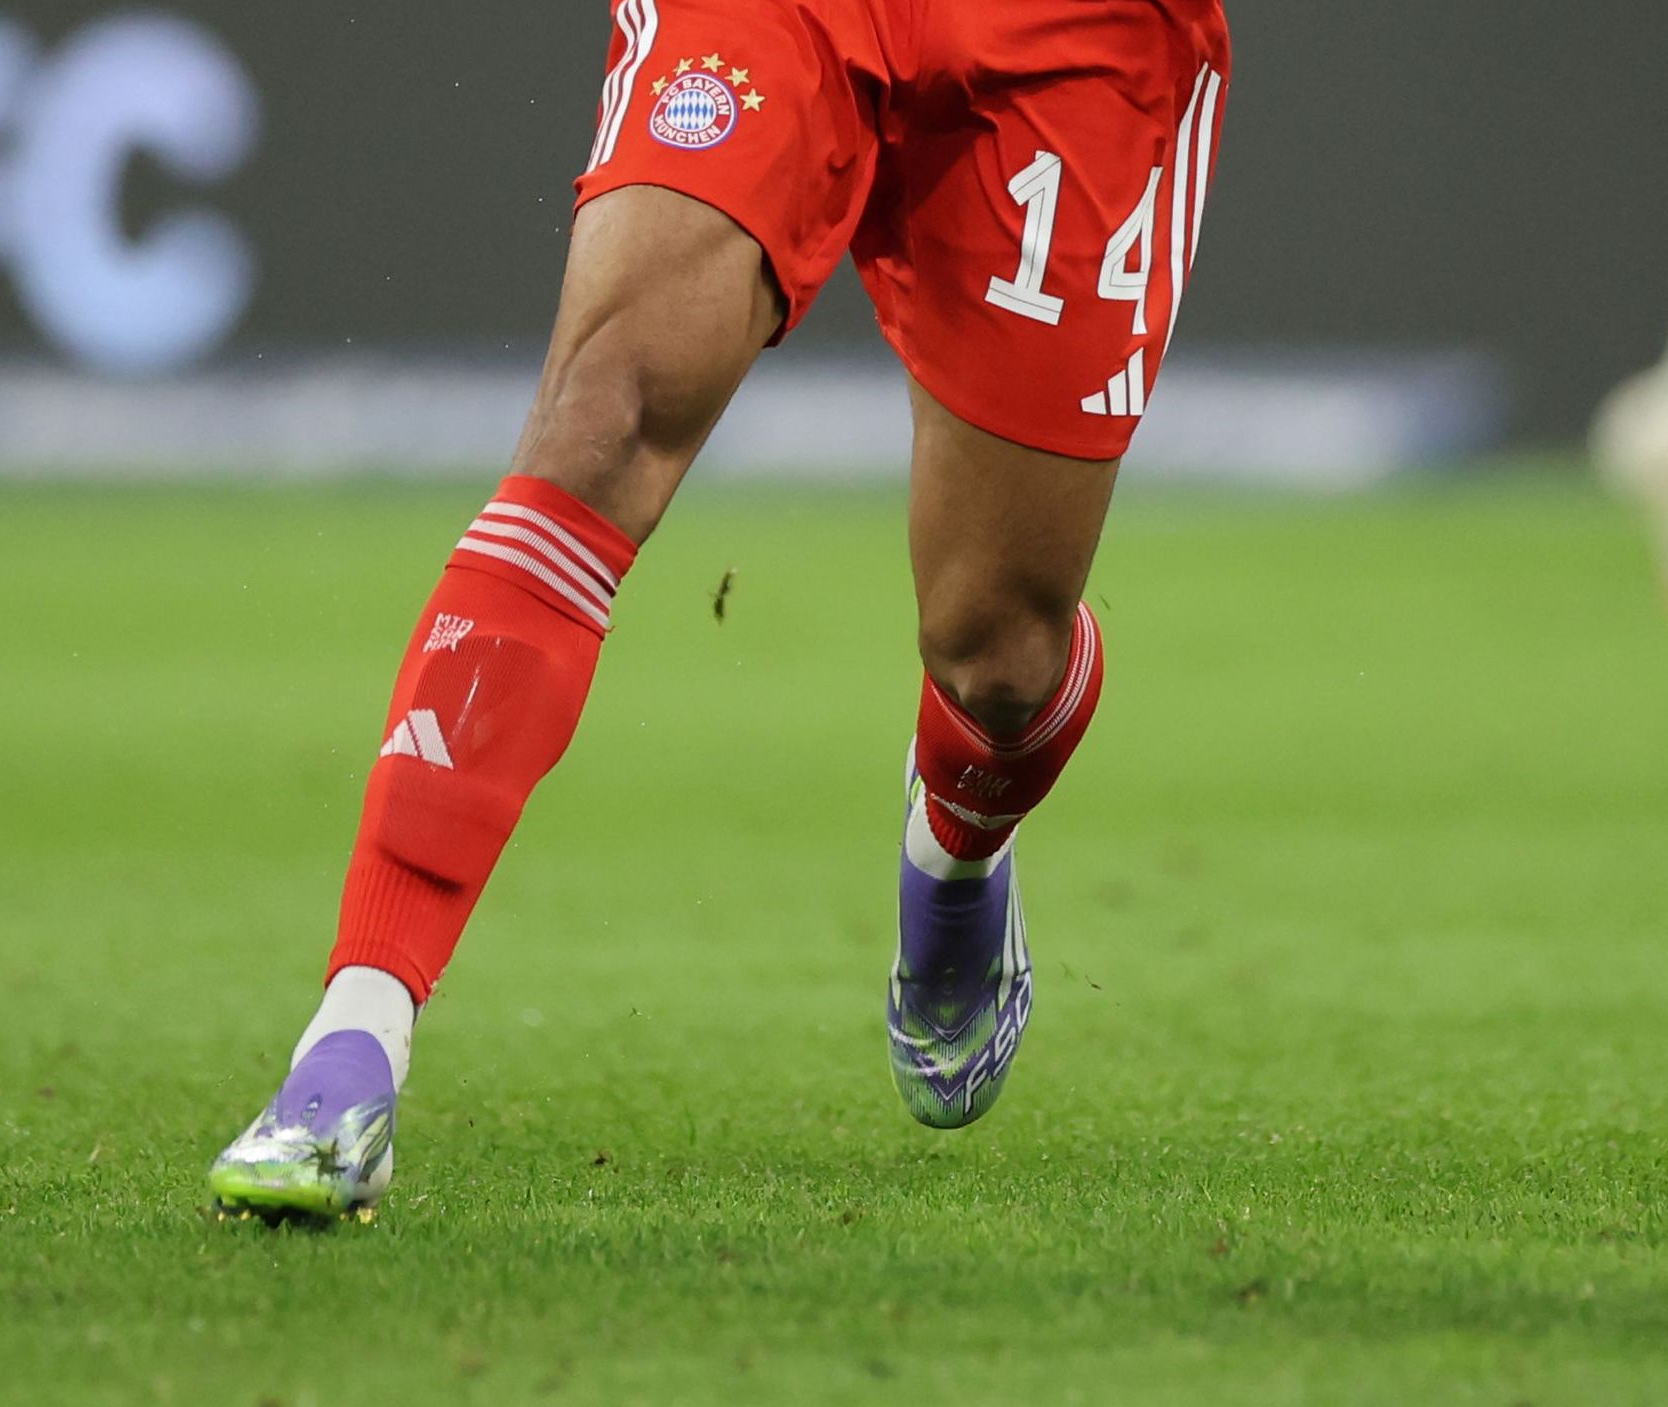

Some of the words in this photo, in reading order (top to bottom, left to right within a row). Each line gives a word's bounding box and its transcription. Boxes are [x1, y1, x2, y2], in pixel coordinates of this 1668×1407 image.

[682, 78, 730, 116] BAYERN
[984, 149, 1164, 336] 14
[963, 970, 1032, 1114] F50
